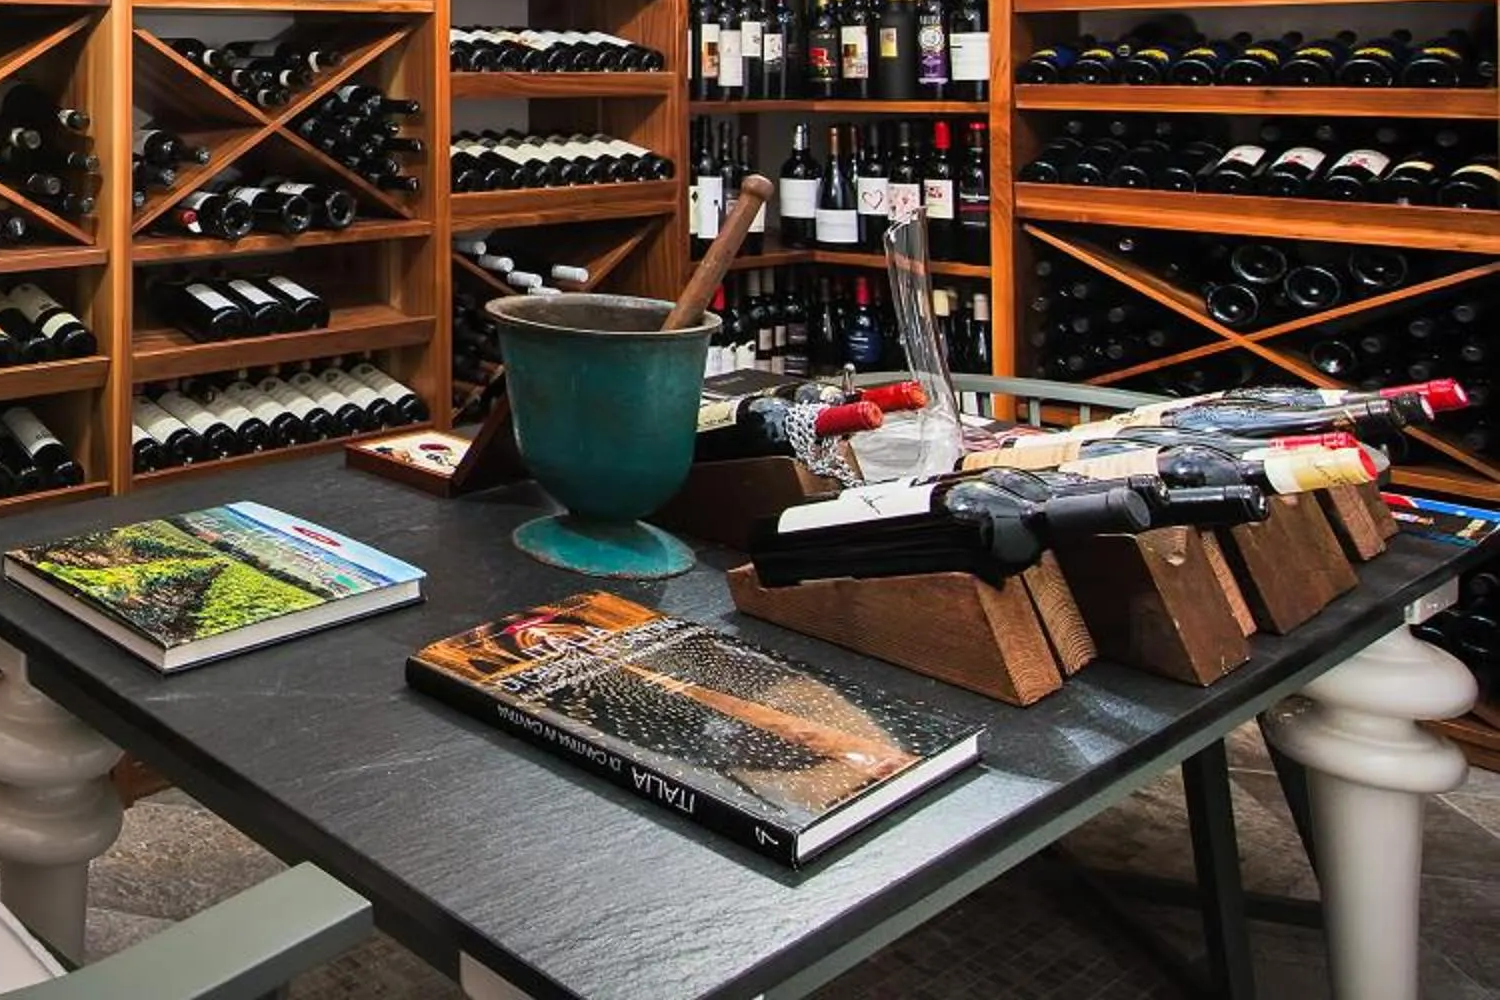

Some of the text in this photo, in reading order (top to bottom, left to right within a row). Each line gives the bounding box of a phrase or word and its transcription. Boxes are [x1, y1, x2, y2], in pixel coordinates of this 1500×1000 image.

[521, 624, 613, 661] ITALIA
[608, 758, 622, 772] DI
[631, 766, 696, 814] ITALIA
